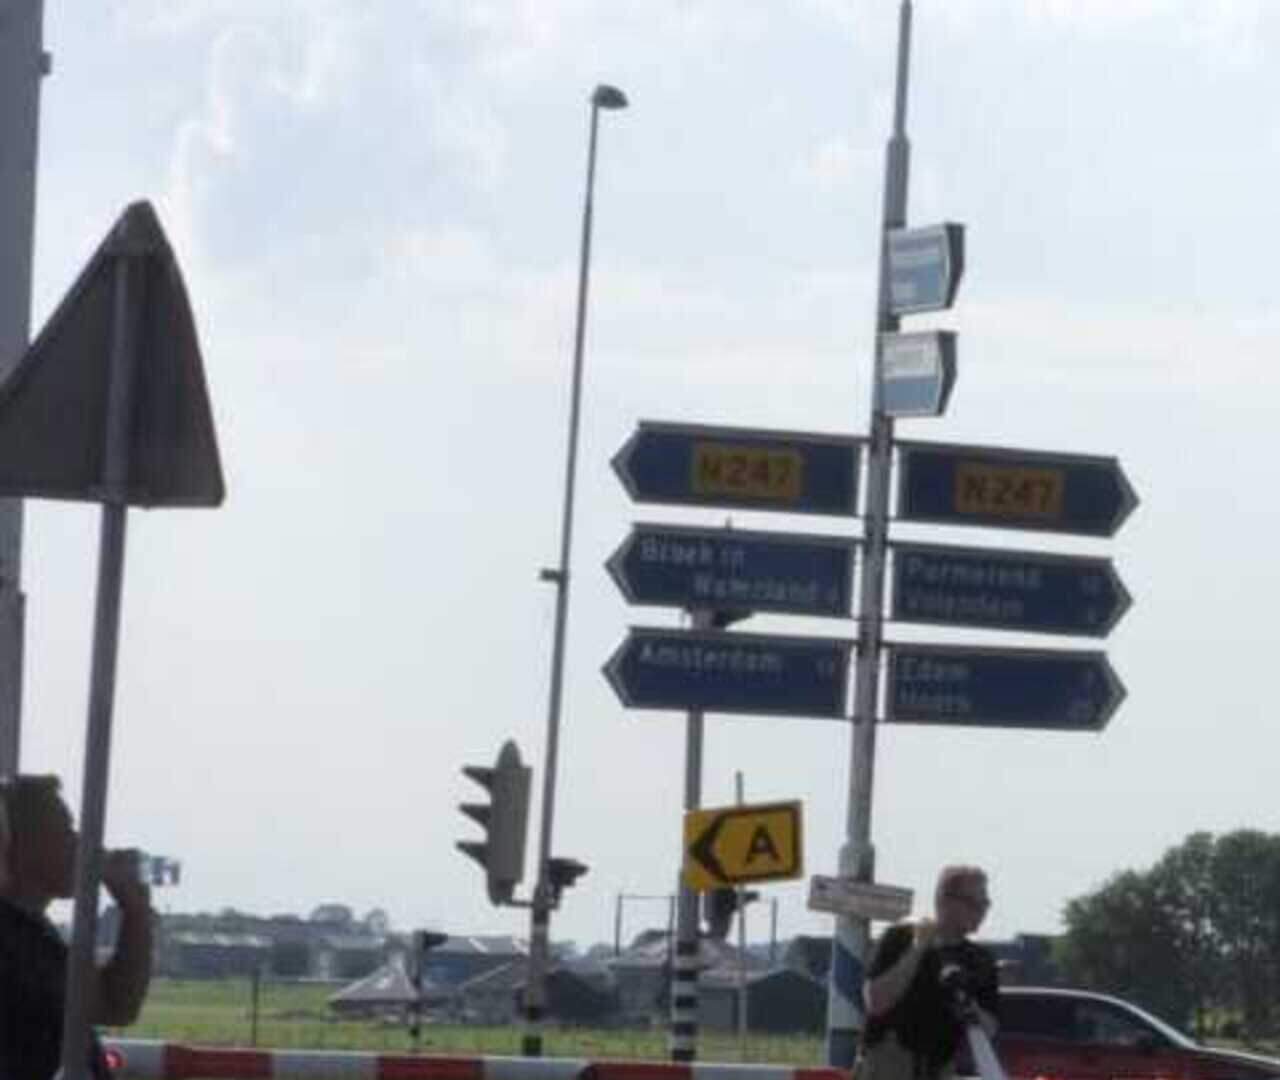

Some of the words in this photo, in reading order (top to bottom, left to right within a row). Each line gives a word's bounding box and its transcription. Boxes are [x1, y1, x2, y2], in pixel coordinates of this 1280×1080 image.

[701, 452, 790, 489] N247
[963, 475, 1054, 512] N247
[639, 643, 782, 673] Amsterdam
[744, 826, 778, 862] A
